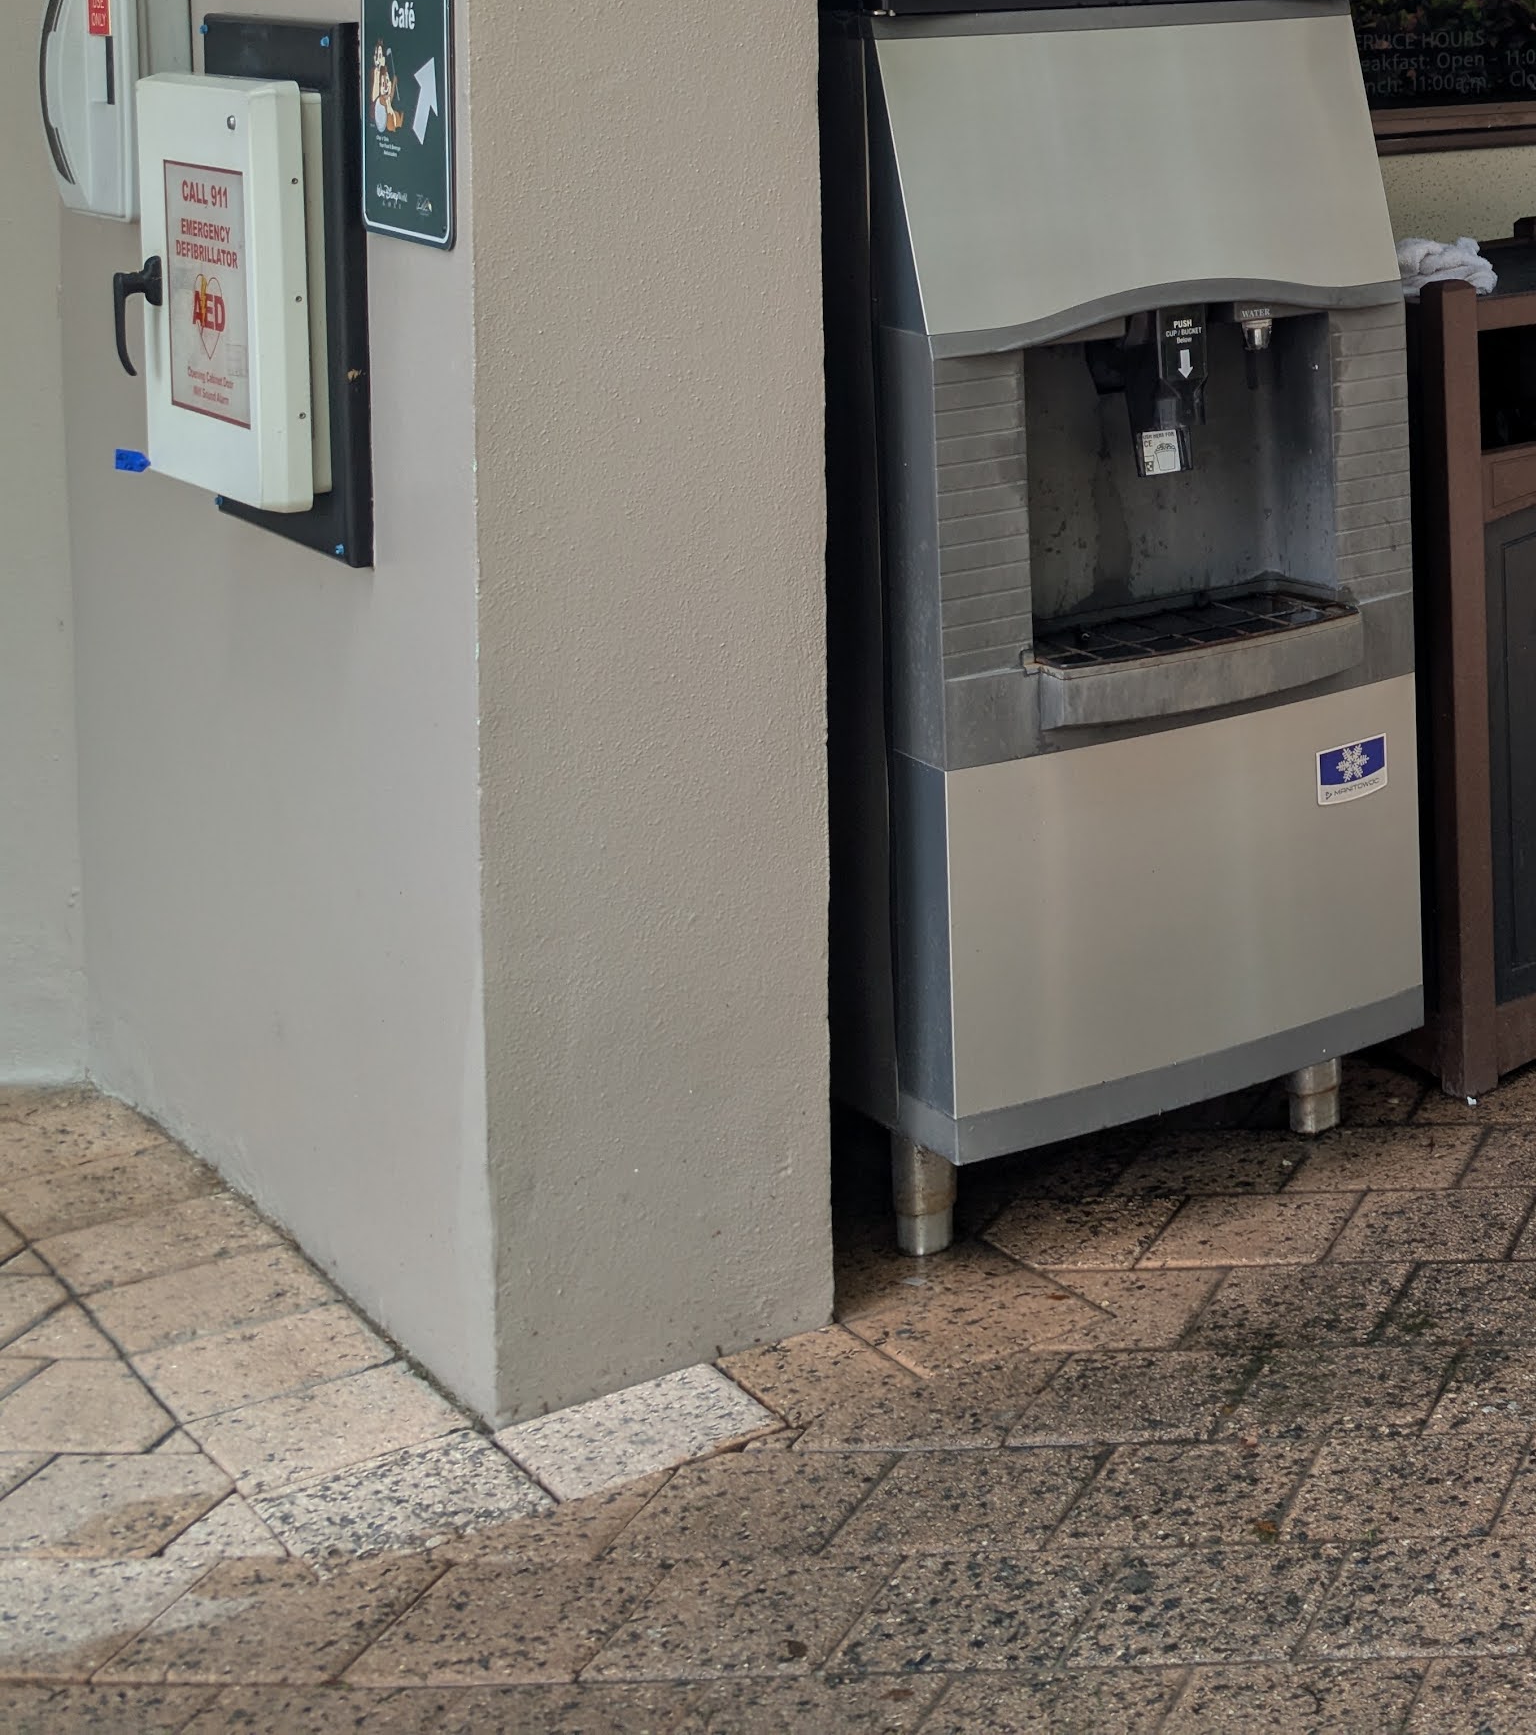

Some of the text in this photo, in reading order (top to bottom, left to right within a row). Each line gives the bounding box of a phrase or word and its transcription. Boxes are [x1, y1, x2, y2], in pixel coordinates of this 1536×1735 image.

[92, 13, 106, 26] ONLY
[392, 0, 415, 30] Café
[1357, 31, 1485, 49] ERVICE HOURS
[1362, 56, 1430, 72] eakfast:
[1437, 53, 1485, 72] Open
[182, 180, 228, 209] CALL 911
[181, 218, 230, 243] EMERGENCY
[176, 239, 238, 269] DEFIBRILLATOR
[192, 290, 225, 332] AED
[1242, 309, 1271, 317] WATER
[1174, 319, 1192, 328] PUSH
[1181, 327, 1202, 335] BUCKET
[1334, 778, 1379, 796] MANITOWOC
